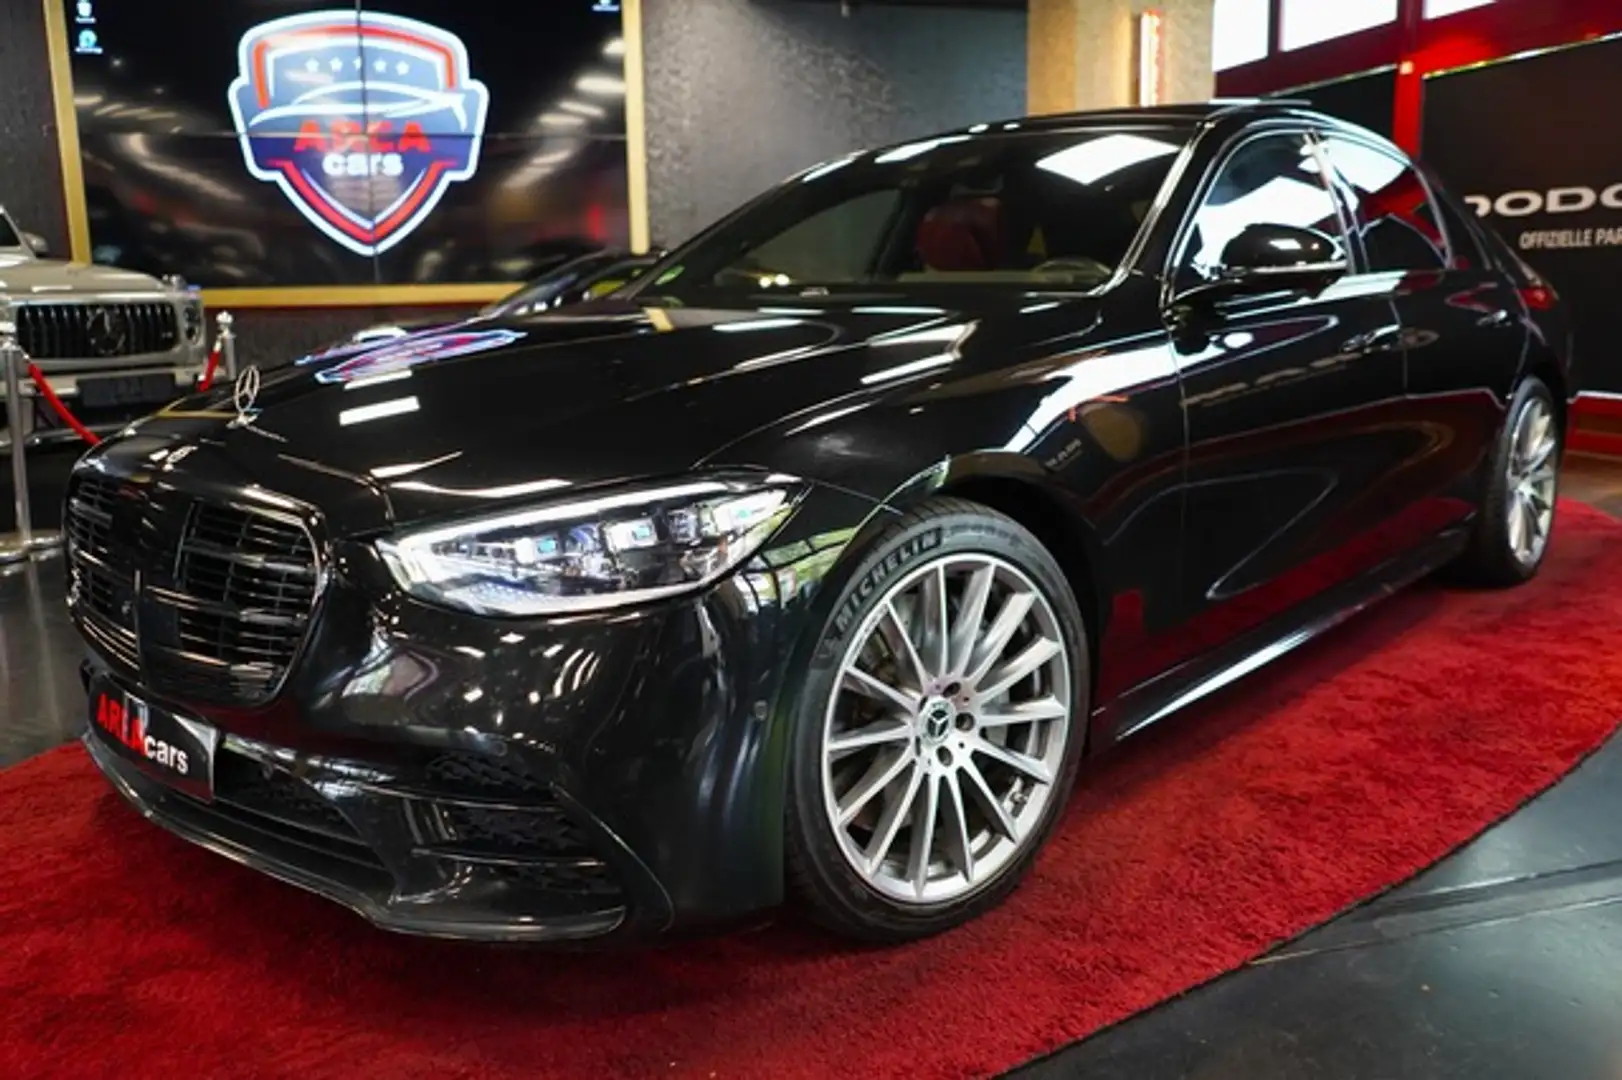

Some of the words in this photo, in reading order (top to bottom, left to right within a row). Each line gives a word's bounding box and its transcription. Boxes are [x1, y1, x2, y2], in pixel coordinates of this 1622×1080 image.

[293, 119, 432, 152] ARCA
[321, 152, 404, 177] cars
[835, 527, 943, 634] MICHELIN
[144, 734, 189, 775] cars
